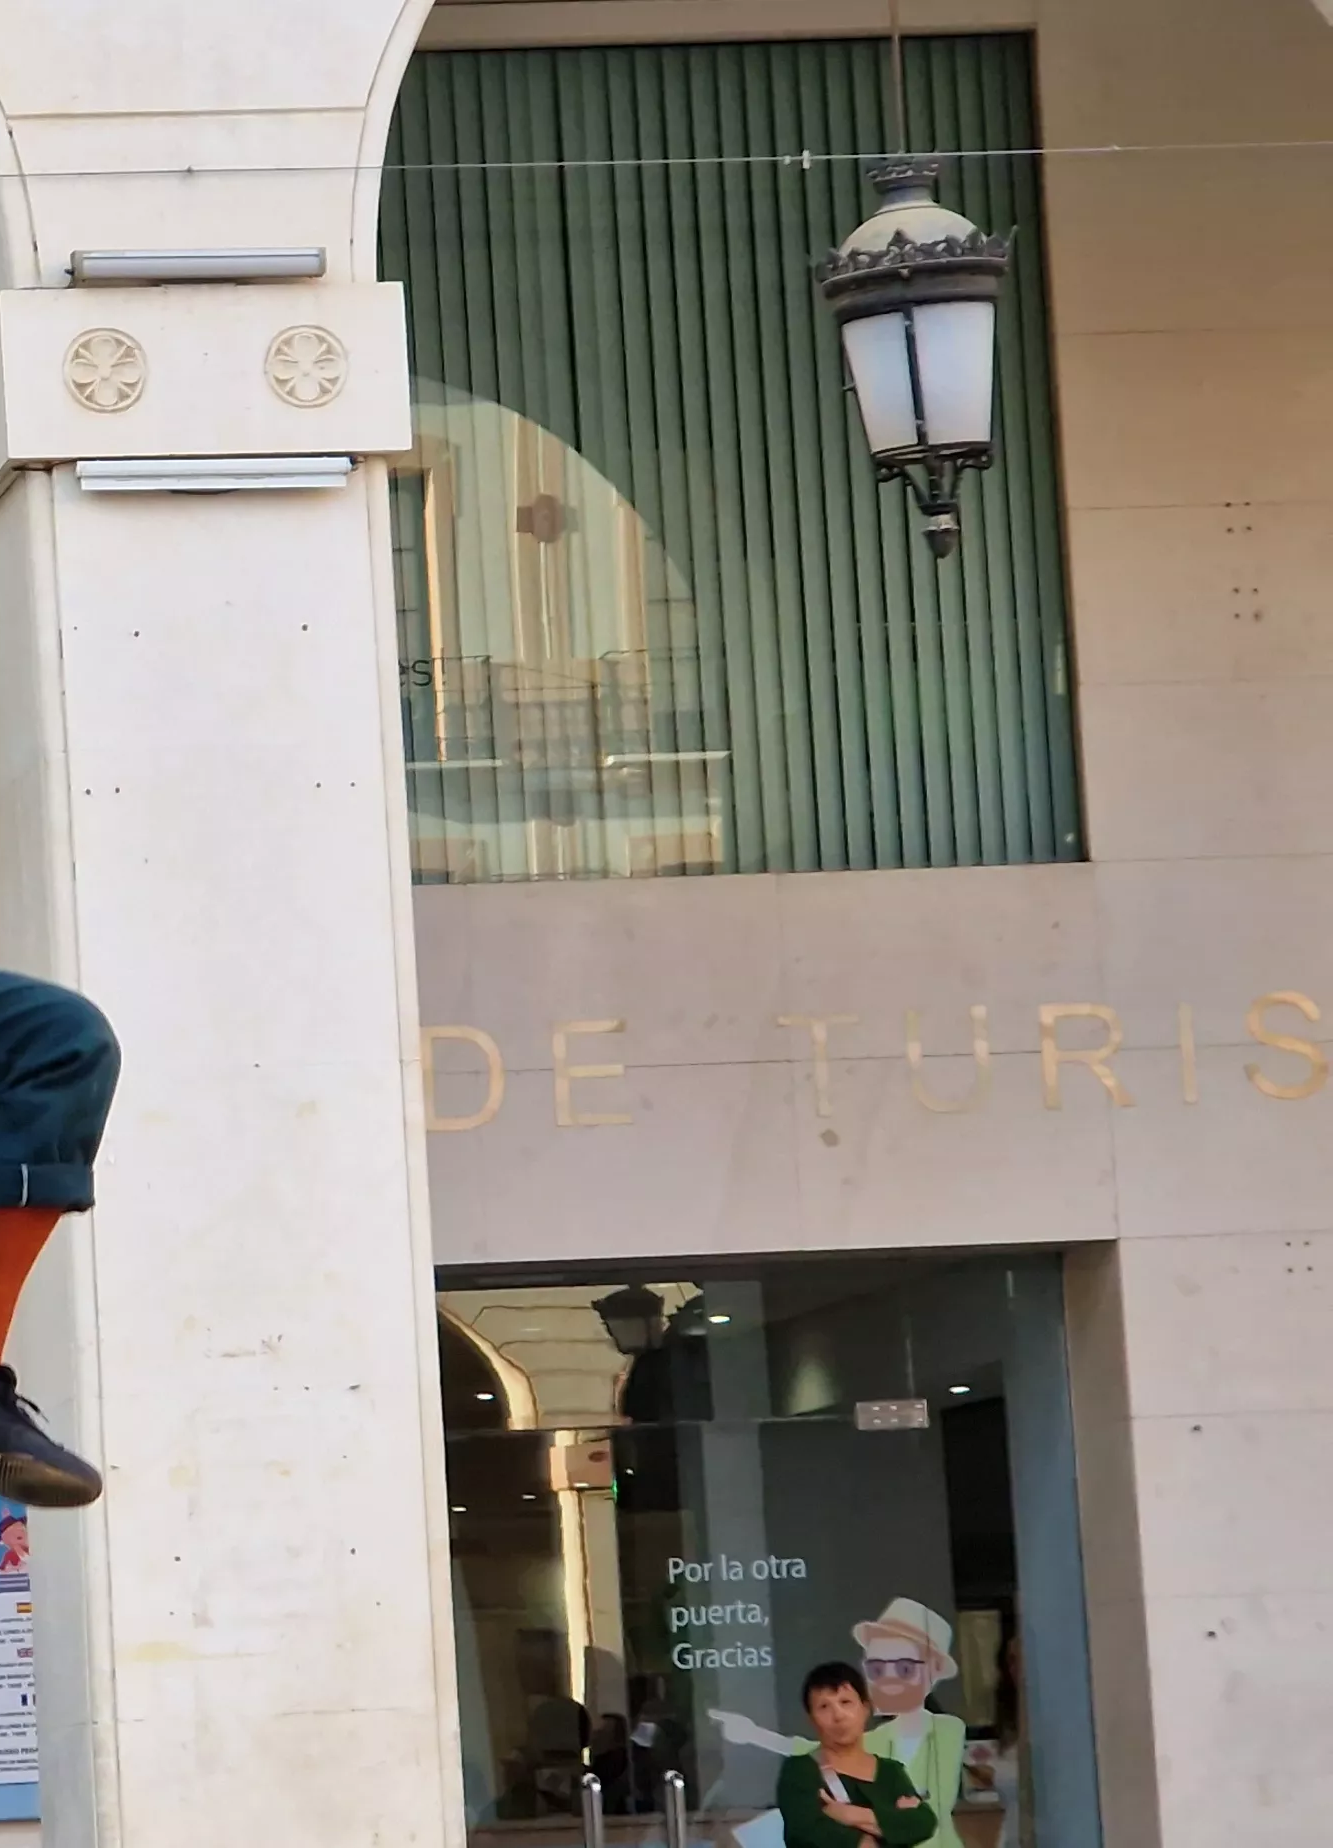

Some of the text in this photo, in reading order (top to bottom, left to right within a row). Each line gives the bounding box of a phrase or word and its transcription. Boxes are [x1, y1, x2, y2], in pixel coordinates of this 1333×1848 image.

[419, 990, 1329, 1132] DE TURIS
[668, 1554, 808, 1584] Por la otra
[670, 1600, 770, 1633] puerta,
[672, 1642, 773, 1669] Gracias
